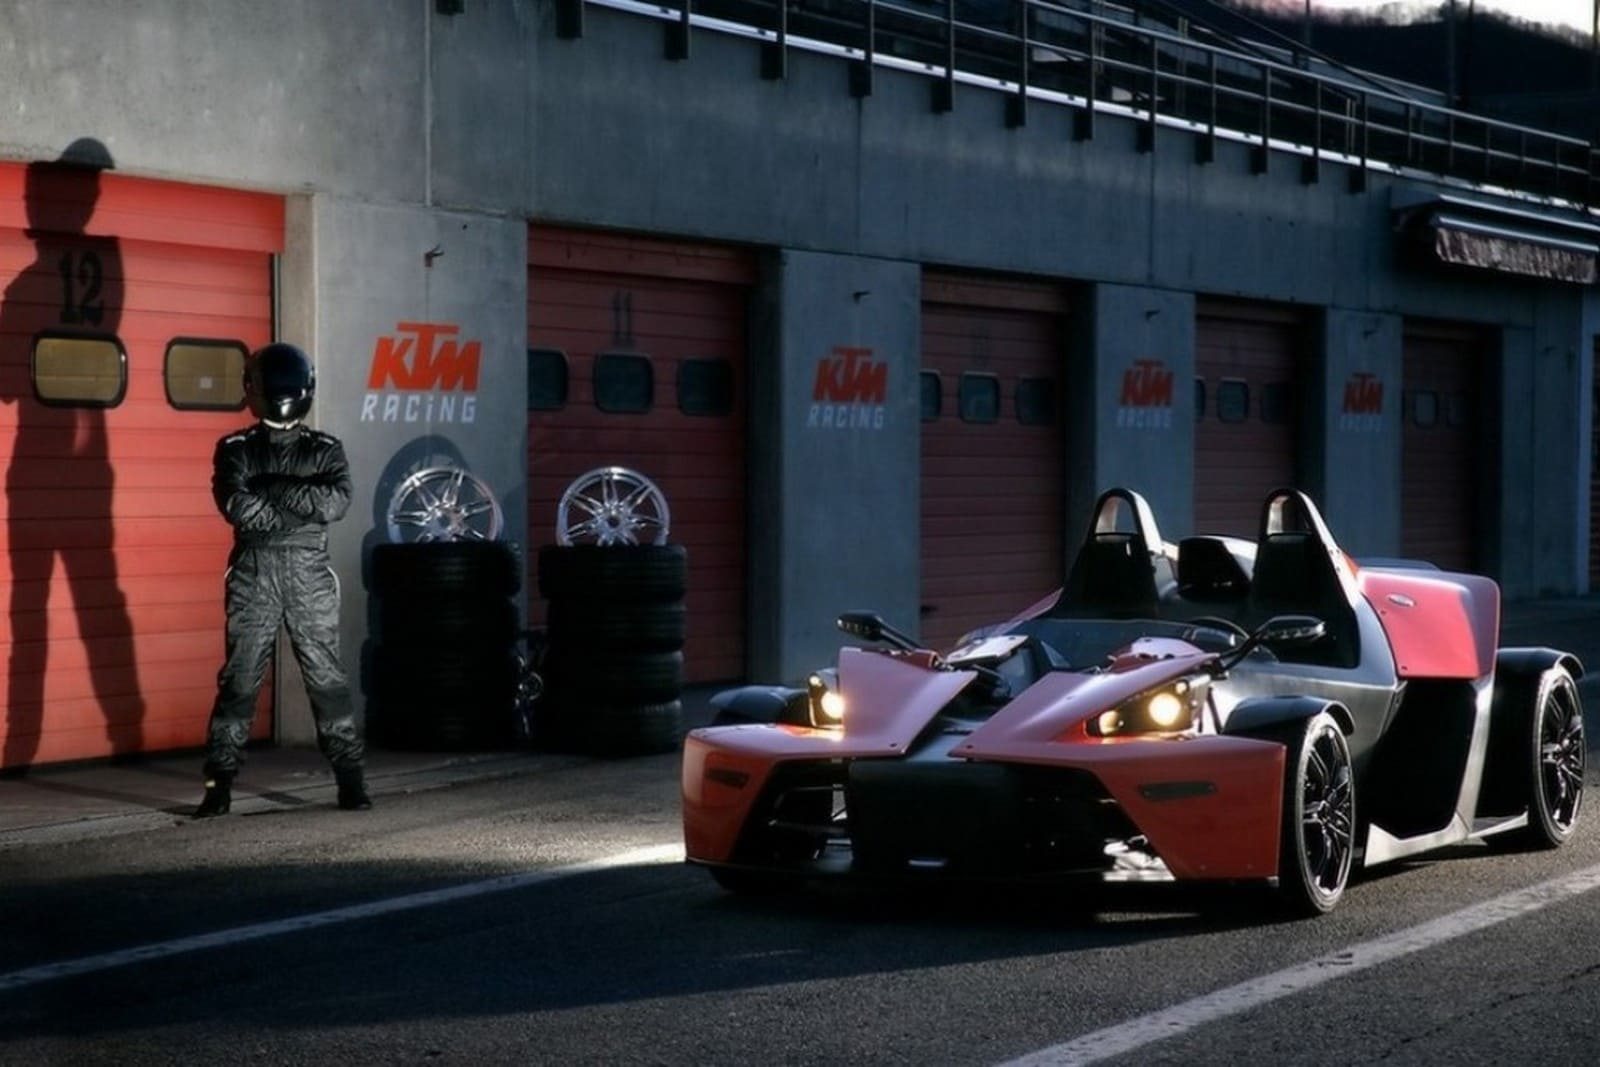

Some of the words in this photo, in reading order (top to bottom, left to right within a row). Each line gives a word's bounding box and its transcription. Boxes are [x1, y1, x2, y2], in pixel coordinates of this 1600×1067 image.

[59, 251, 104, 327] 12
[367, 322, 482, 391] KTM
[813, 346, 888, 403] KTM
[1120, 359, 1174, 406] KTM
